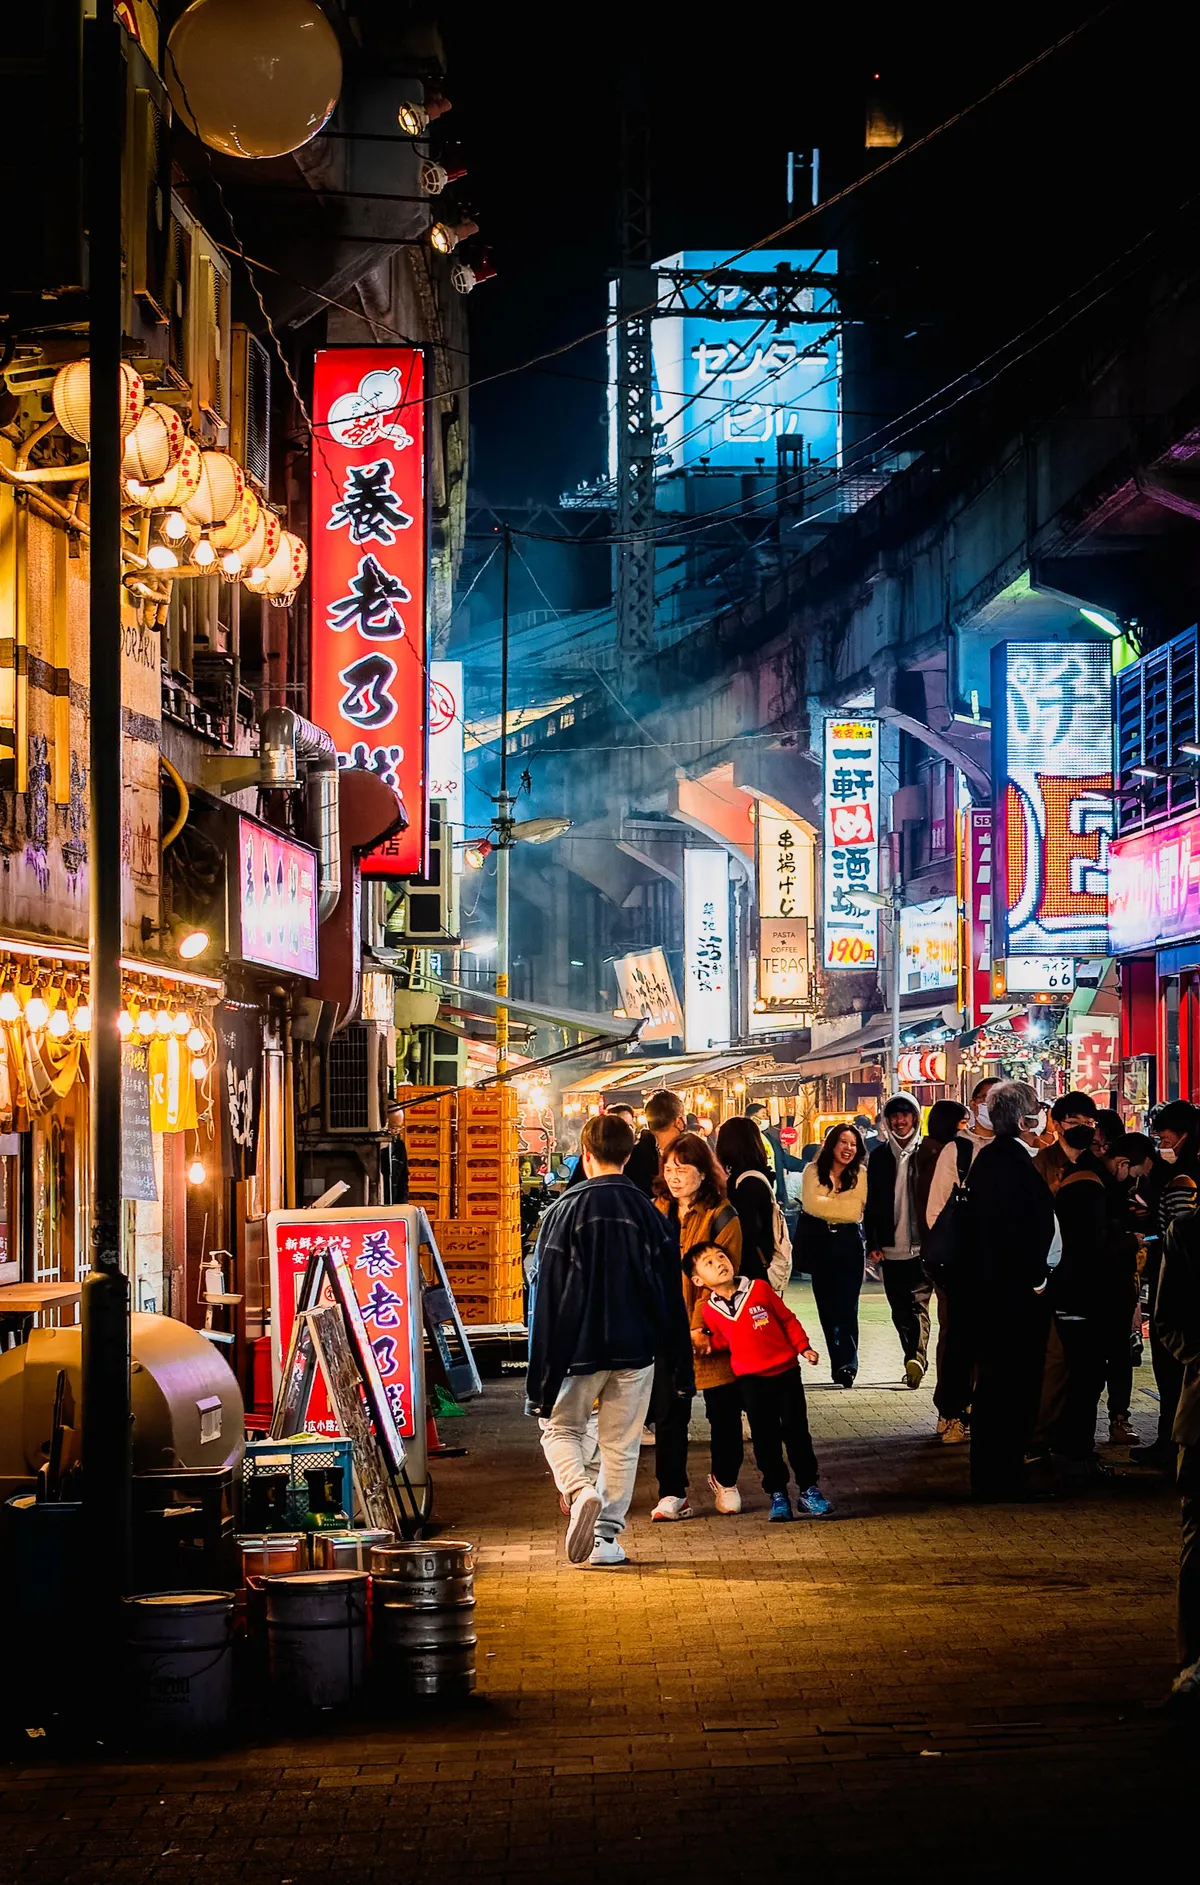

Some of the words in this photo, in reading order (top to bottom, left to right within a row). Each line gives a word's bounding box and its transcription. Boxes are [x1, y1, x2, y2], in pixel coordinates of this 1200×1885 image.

[692, 339, 828, 381] センター
[723, 403, 798, 442] ビル
[326, 459, 413, 798] 養老乃
[830, 748, 874, 917] 一軒め酒場
[777, 829, 796, 916] 串揚げじ
[763, 957, 806, 974] TERAS
[828, 938, 876, 962] 190円
[1049, 973, 1071, 987] 66
[446, 1241, 486, 1251] ホッピー
[458, 1307, 485, 1320] ッピー
